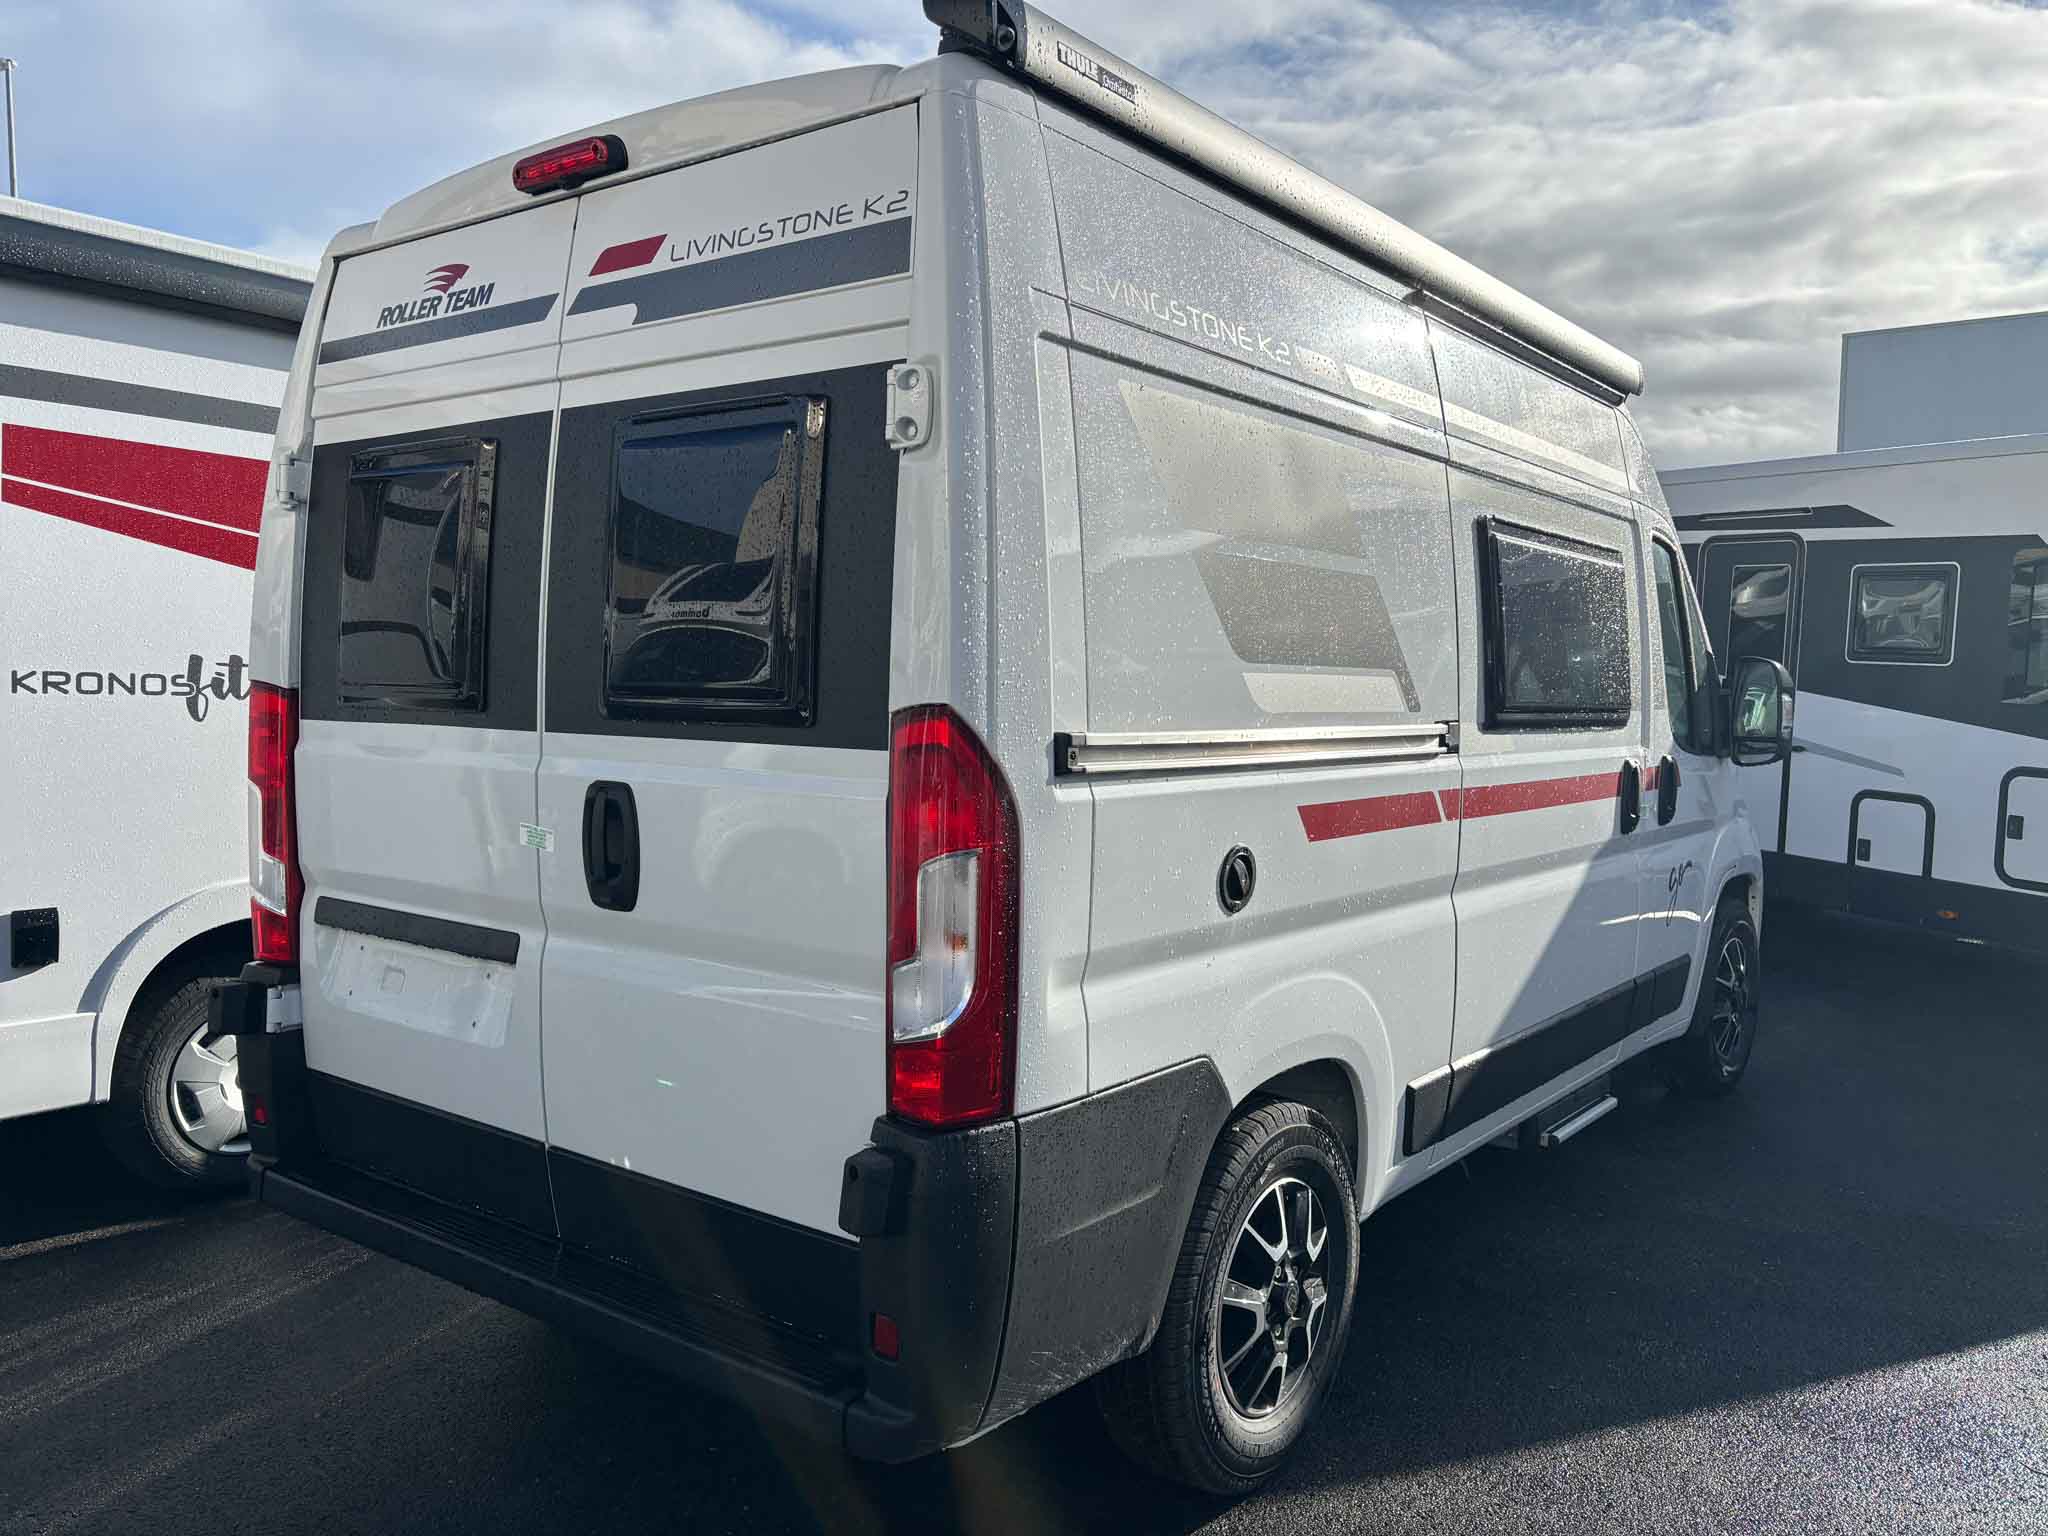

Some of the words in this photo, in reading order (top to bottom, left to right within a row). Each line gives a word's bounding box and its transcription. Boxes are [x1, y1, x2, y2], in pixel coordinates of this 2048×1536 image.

[1058, 43, 1099, 80] THULE
[670, 203, 854, 262] LIVINGSTONE
[863, 190, 909, 219] K2
[376, 295, 443, 328] ROLLER
[444, 282, 496, 313] TEAM
[1077, 271, 1254, 351] LIVINGSTONE
[1256, 332, 1292, 365] K2
